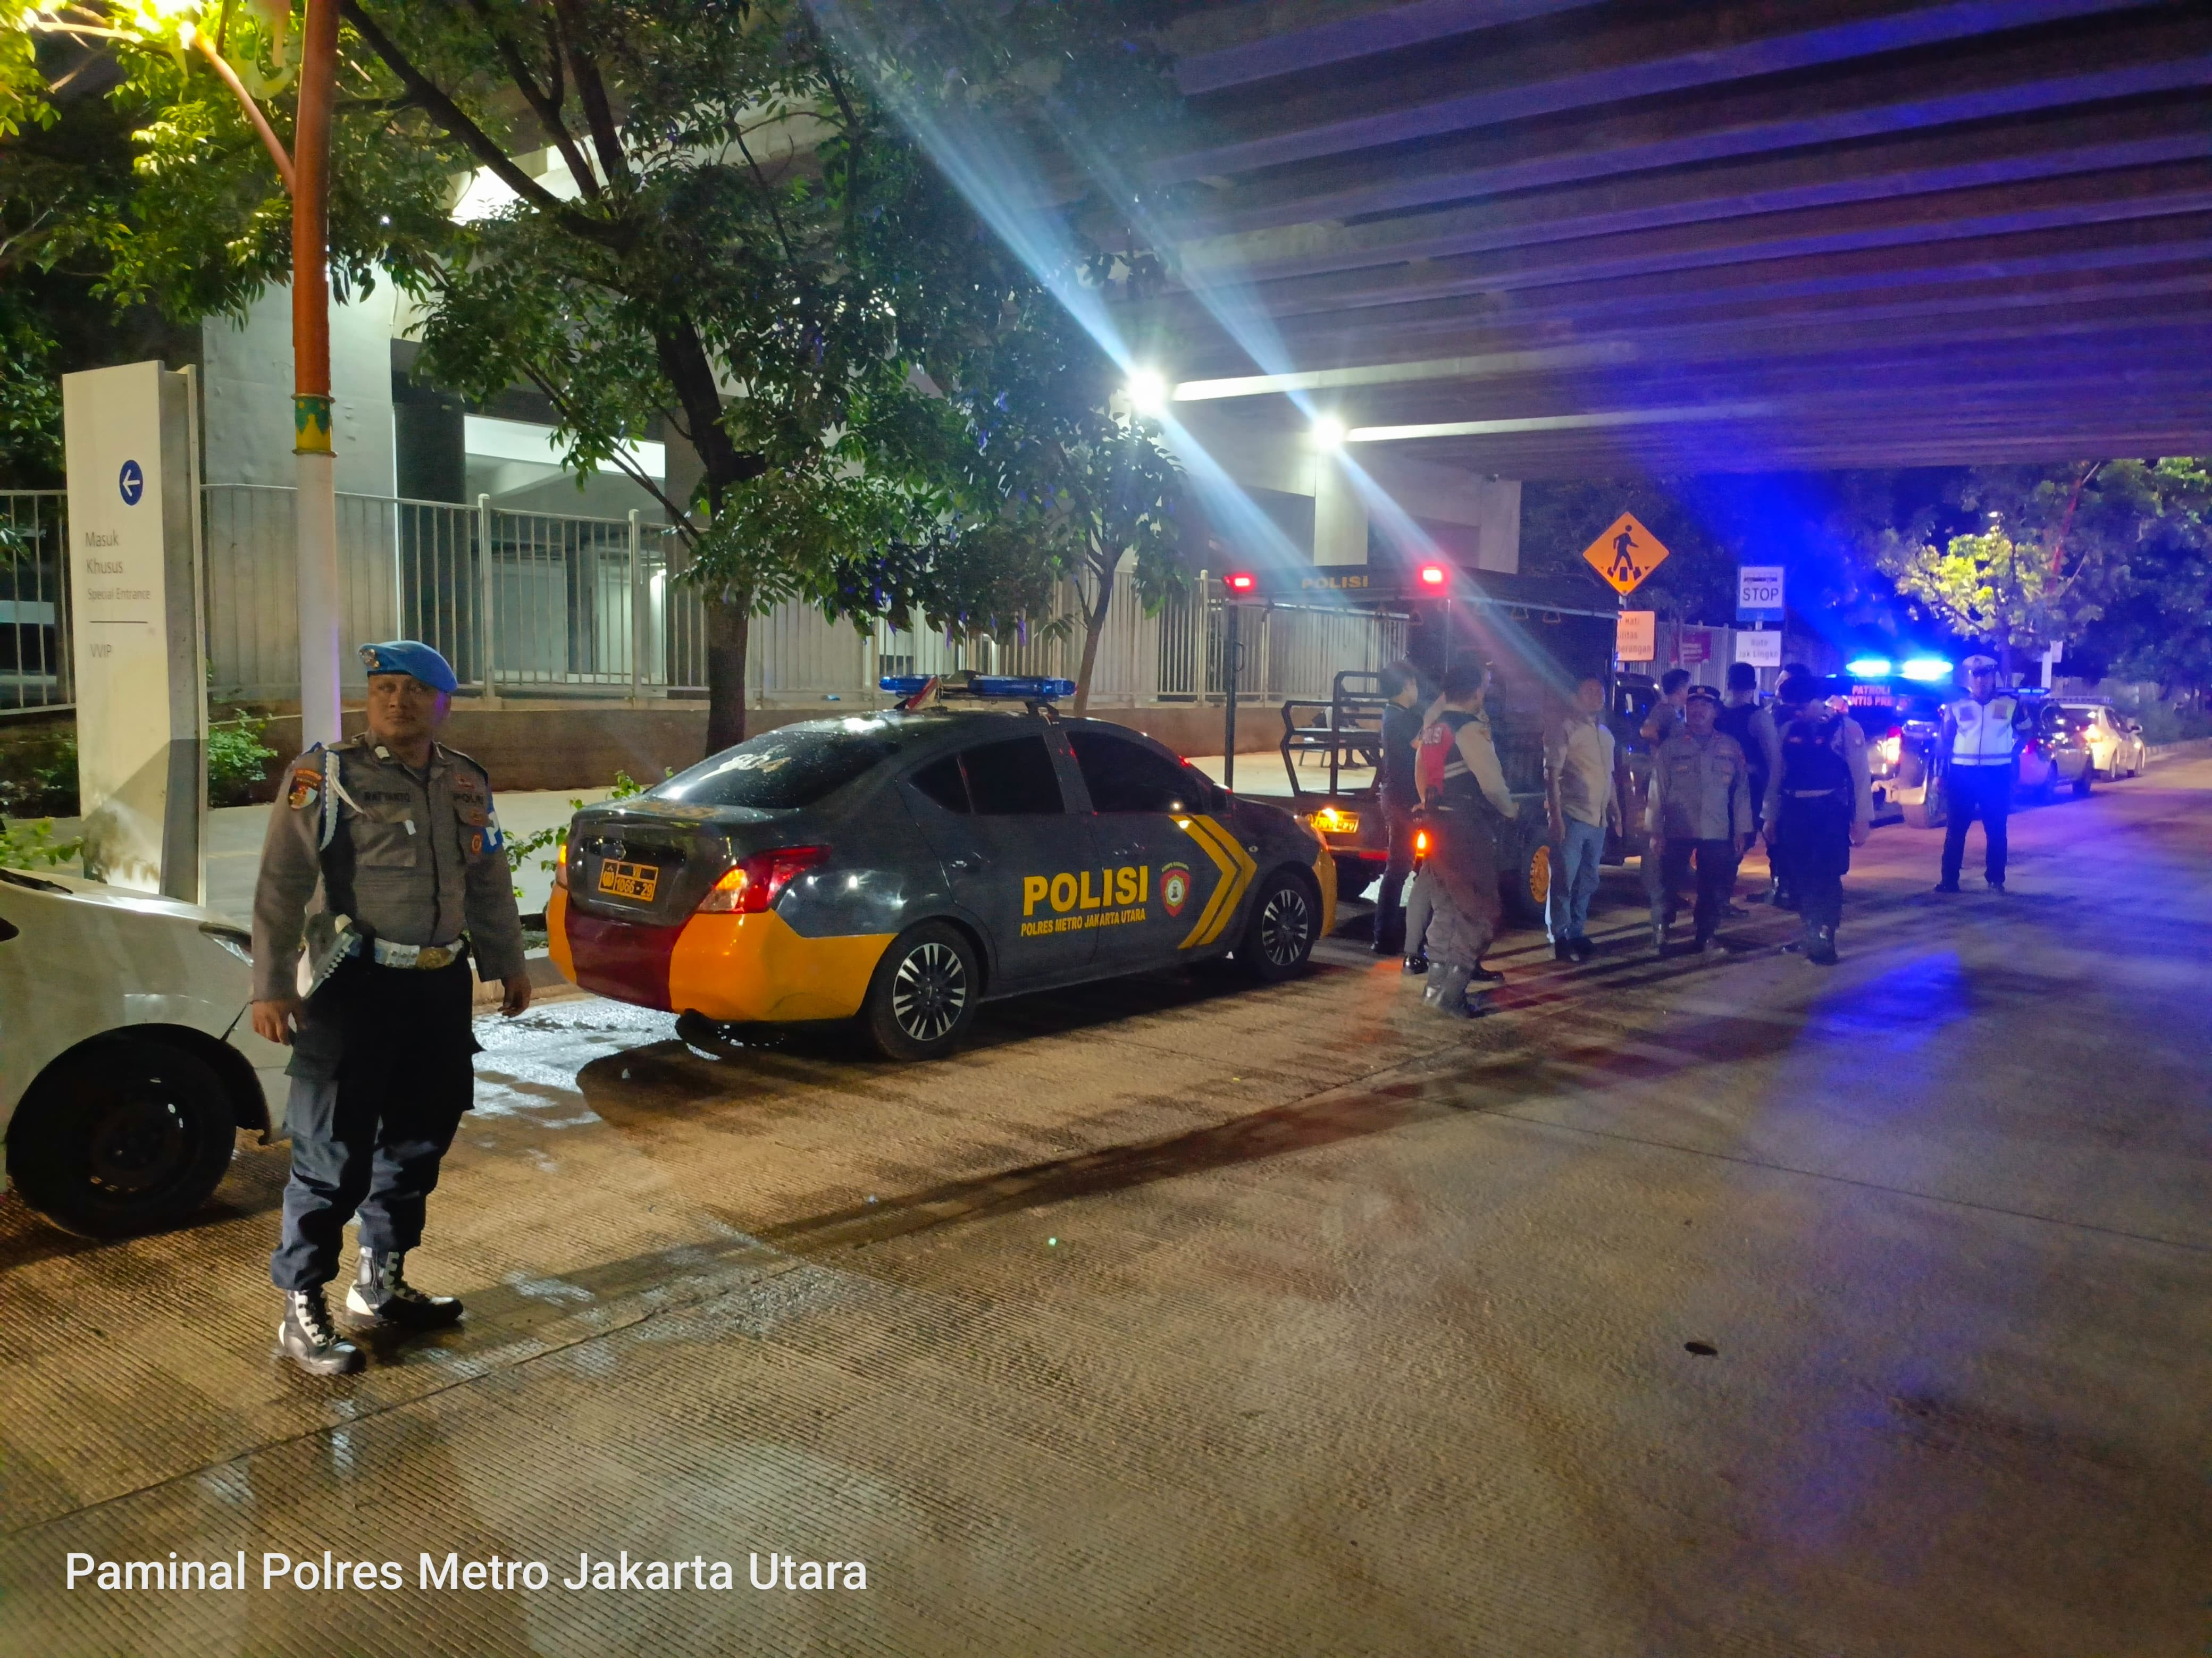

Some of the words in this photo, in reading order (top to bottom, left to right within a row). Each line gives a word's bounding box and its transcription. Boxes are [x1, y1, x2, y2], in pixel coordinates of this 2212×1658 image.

[85, 529, 119, 548] Masuk
[86, 558, 123, 575] Khusus
[1301, 576, 1368, 590] POLISI
[88, 587, 114, 602] Special
[116, 587, 151, 600] Entrance
[1742, 587, 1779, 601] STOP
[89, 643, 112, 658] VVIP
[1023, 865, 1149, 916] POLISI
[1020, 919, 1053, 938] POLRES
[1055, 915, 1083, 932] METRO
[1084, 911, 1119, 929] JAKARTA
[1120, 907, 1146, 924] UTARA
